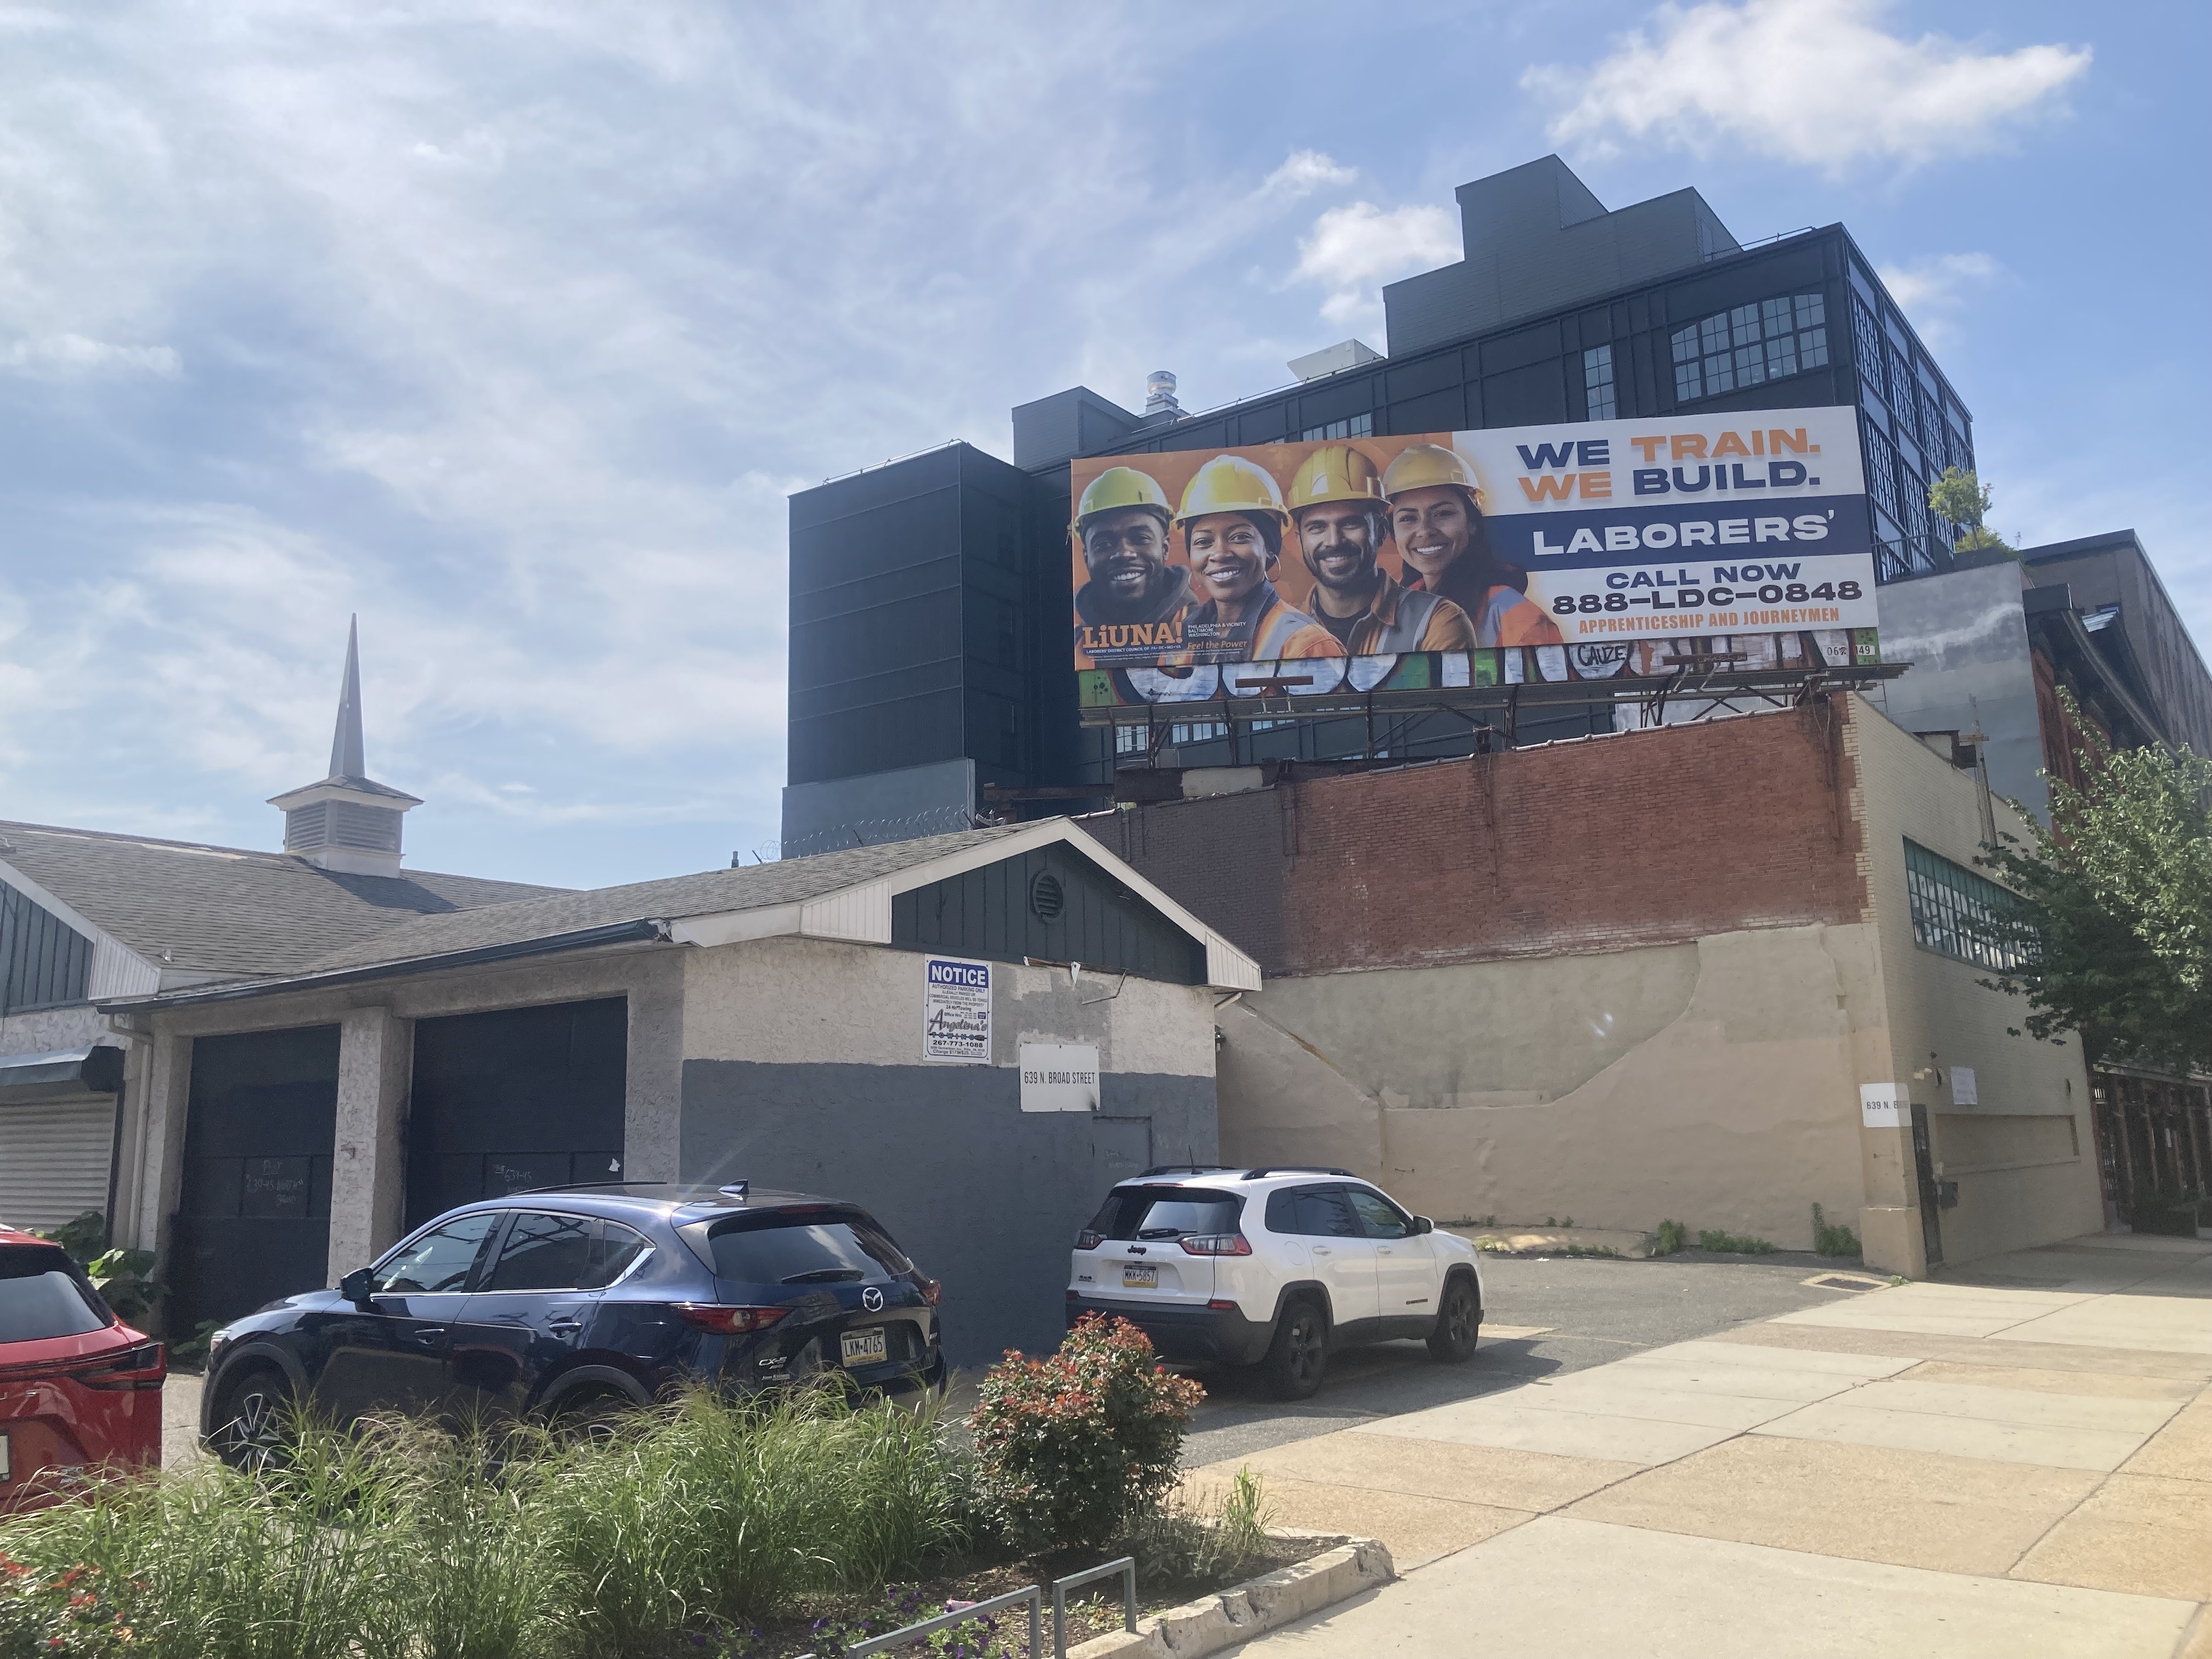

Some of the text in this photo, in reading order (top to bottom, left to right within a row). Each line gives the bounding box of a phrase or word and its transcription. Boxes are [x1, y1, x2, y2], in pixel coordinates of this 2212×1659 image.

[1515, 428, 1820, 470] WE TRAIN.
[1518, 461, 1820, 502] WE BUILD.
[1533, 510, 1835, 555] LABORERS'
[1606, 563, 1801, 590] CALL NOW
[1552, 581, 1863, 614] 888-LDC-0848
[1579, 607, 1840, 634] APPRENTICESHIP AND JOURNEYMEN
[1082, 622, 1183, 648] LiUNA!
[1187, 640, 1248, 650] Feel the Power
[932, 965, 986, 986] NOTICE
[933, 1040, 984, 1048] 267-773-1088
[1024, 1071, 1095, 1084] 639 N. BROAD STREET
[1866, 1101, 1881, 1109] 639
[1127, 1245, 1147, 1256] Jeep
[759, 1357, 787, 1366] CX-5
